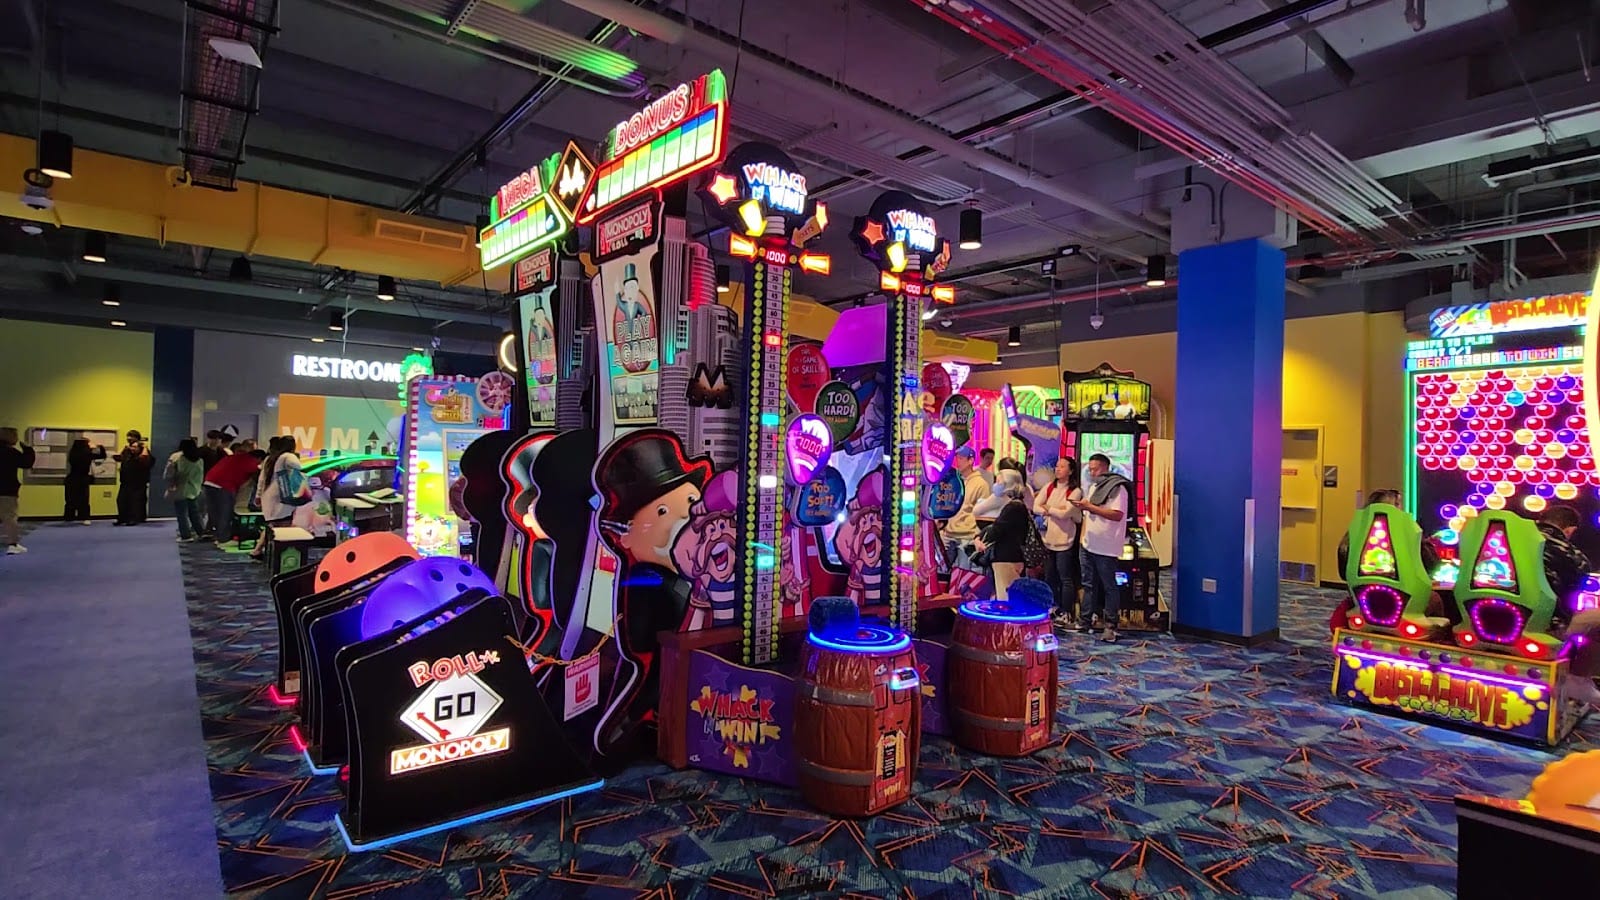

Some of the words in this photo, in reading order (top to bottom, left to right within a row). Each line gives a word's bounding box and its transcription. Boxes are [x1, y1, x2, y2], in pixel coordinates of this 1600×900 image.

[614, 84, 689, 155] BONUS
[500, 165, 542, 213] MEGA
[743, 162, 808, 195] WHACK
[768, 187, 806, 215] WIN!
[605, 209, 648, 240] MONOPOLY
[887, 208, 937, 235] WHACK
[766, 250, 786, 264] 1000
[615, 315, 651, 344] PLAY
[613, 337, 658, 366] AGAIN
[1417, 356, 1451, 368] BEAT
[1505, 350, 1523, 361] TO
[1528, 347, 1558, 359] WIN
[827, 391, 850, 405] TOO
[951, 402, 968, 414] TOO
[282, 426, 318, 449] W
[330, 428, 359, 450] M
[434, 691, 476, 722] GO
[699, 690, 775, 722] WHACK
[1398, 695, 1478, 722] FRENZY
[395, 730, 508, 770] MONOPOLY
